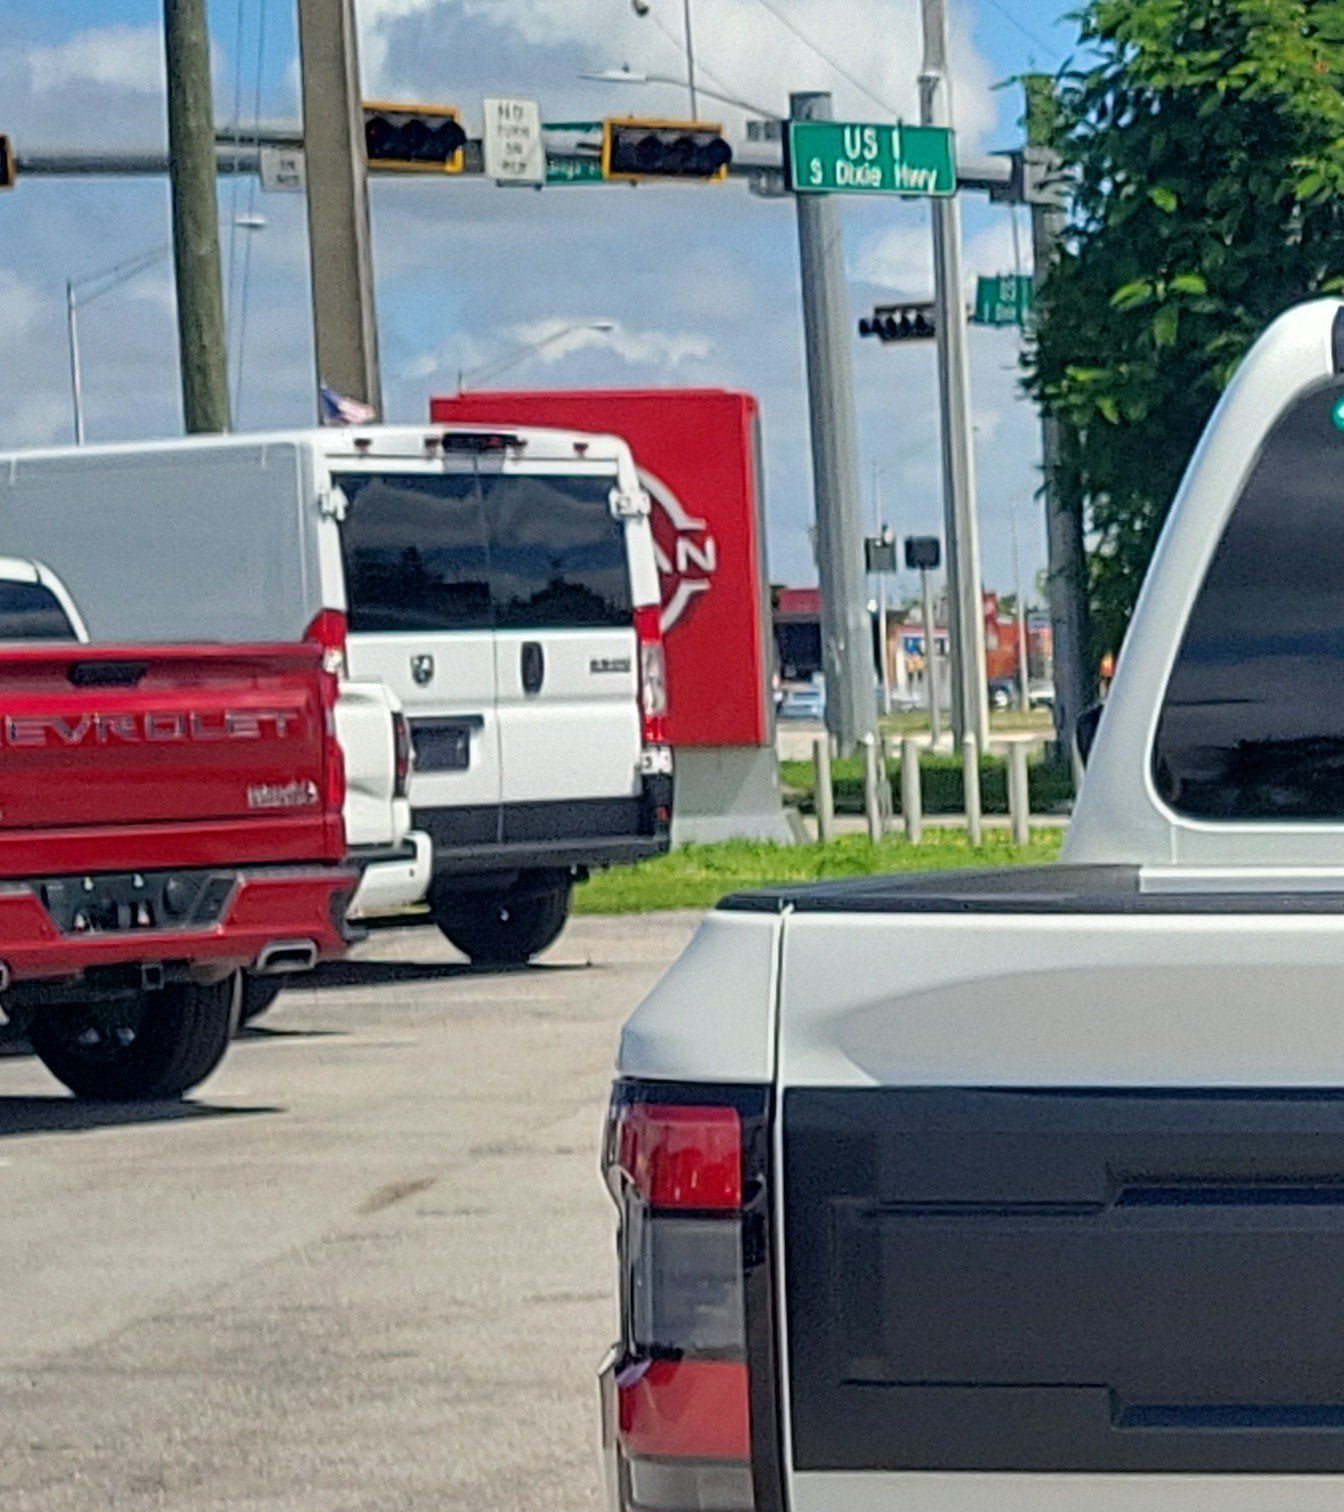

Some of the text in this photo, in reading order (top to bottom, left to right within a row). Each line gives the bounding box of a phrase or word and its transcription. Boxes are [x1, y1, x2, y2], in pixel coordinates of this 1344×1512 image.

[844, 125, 878, 160] US
[809, 157, 937, 195] S Dixie Hwy
[0, 709, 298, 746] EVROLET
